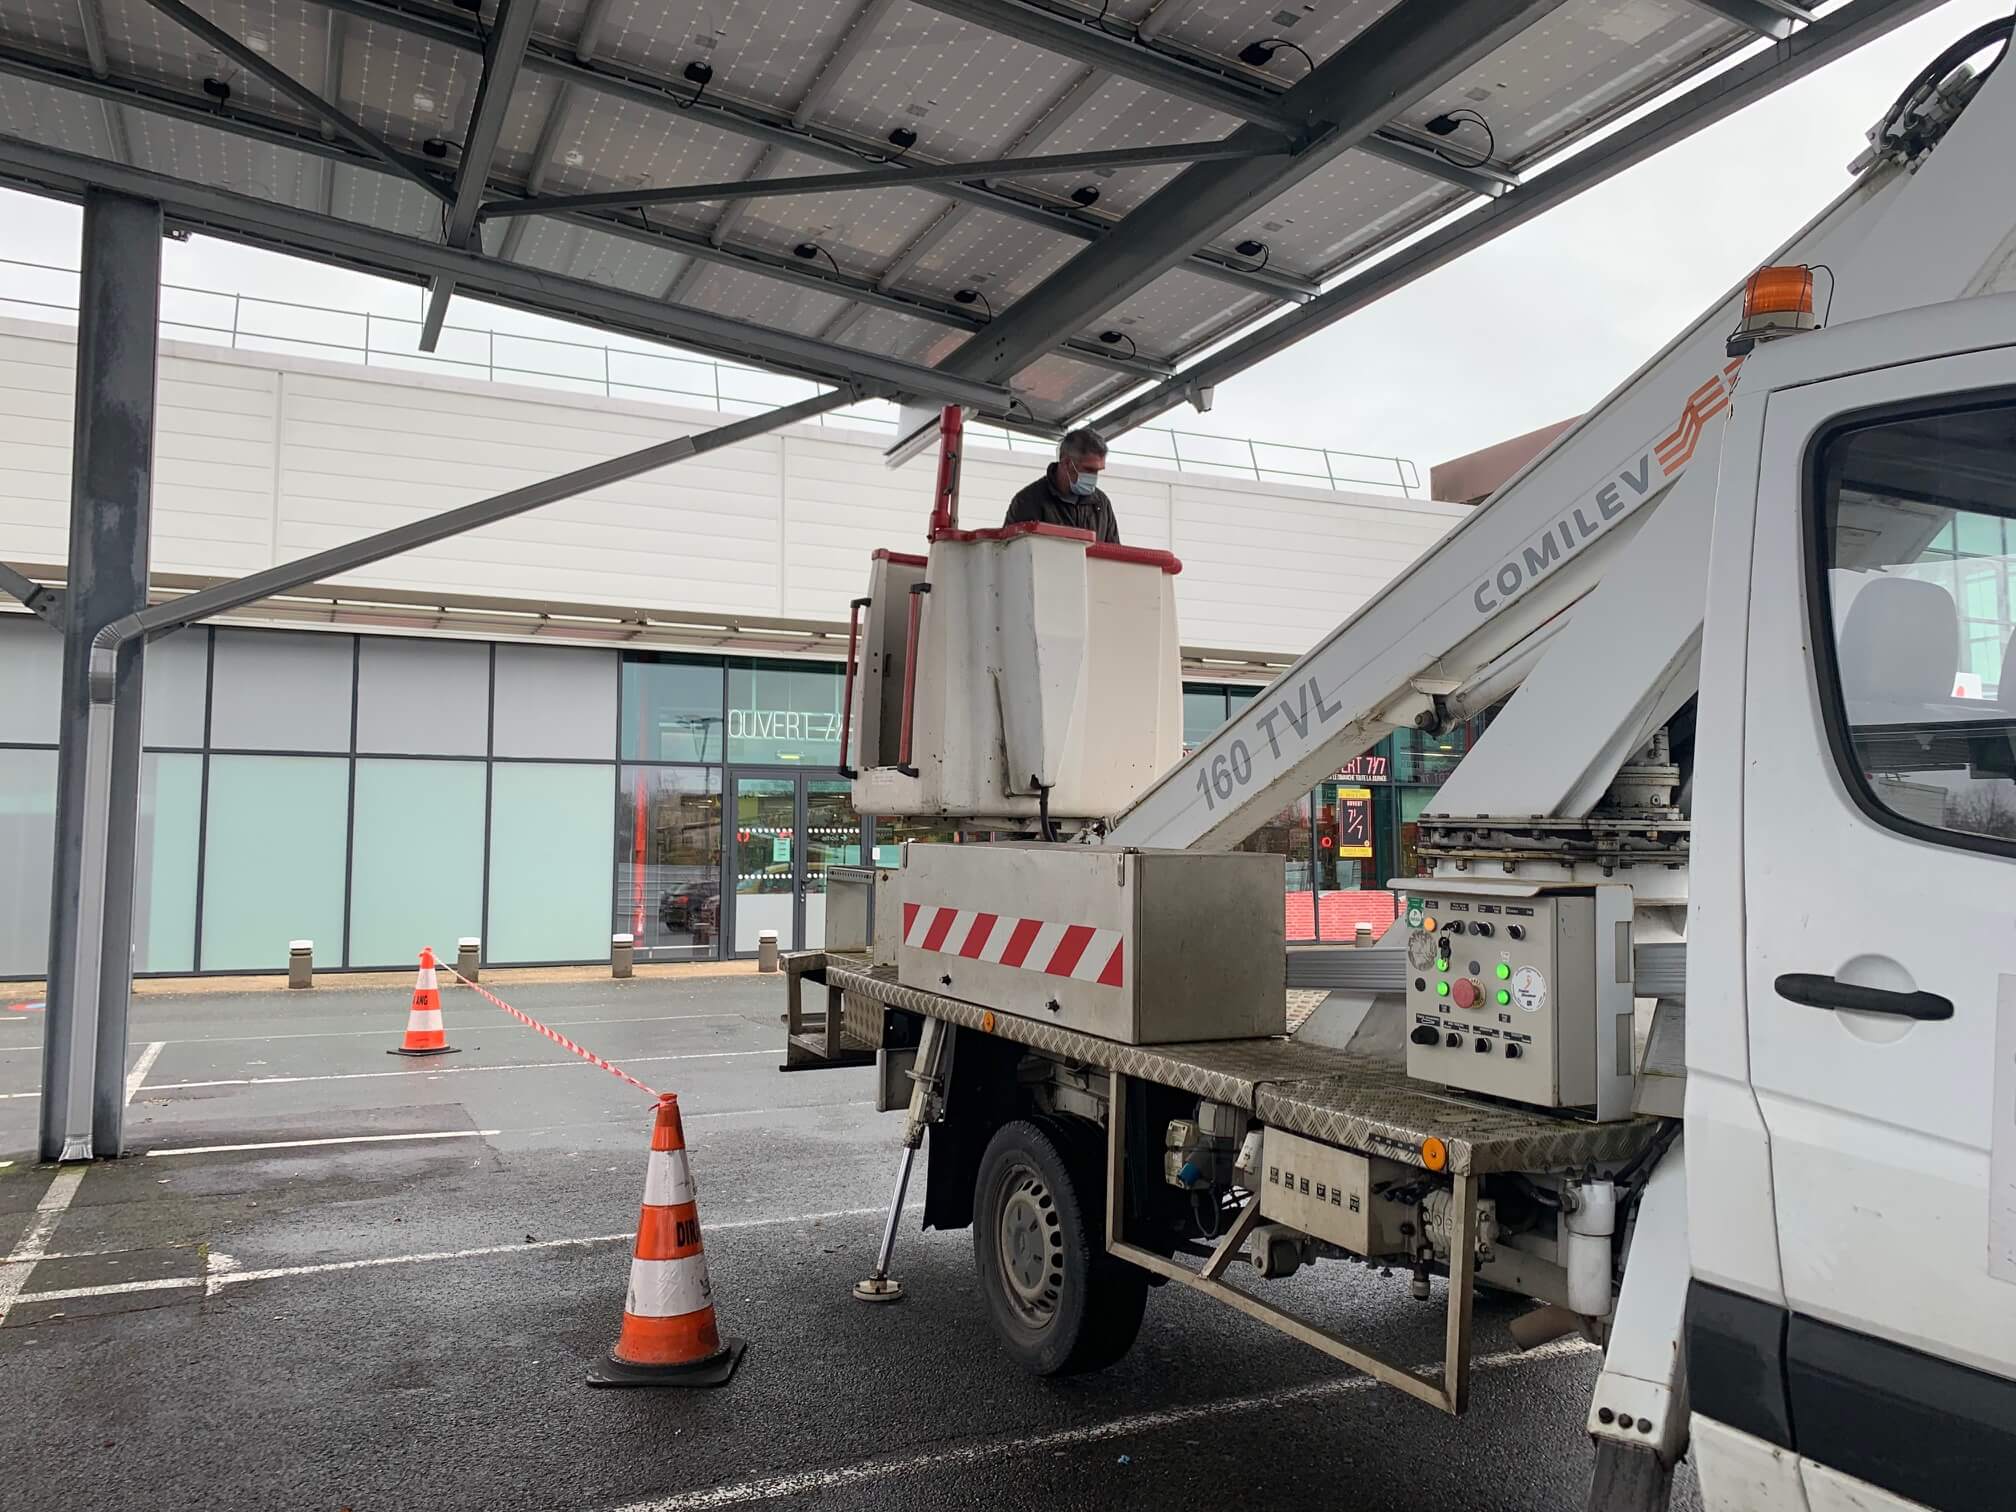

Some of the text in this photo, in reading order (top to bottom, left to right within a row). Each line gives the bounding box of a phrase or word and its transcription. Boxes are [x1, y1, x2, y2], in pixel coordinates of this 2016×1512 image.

[1473, 454, 1649, 614] COMILEV
[728, 709, 813, 741] OUVERT
[1196, 676, 1342, 811] 160 TVL
